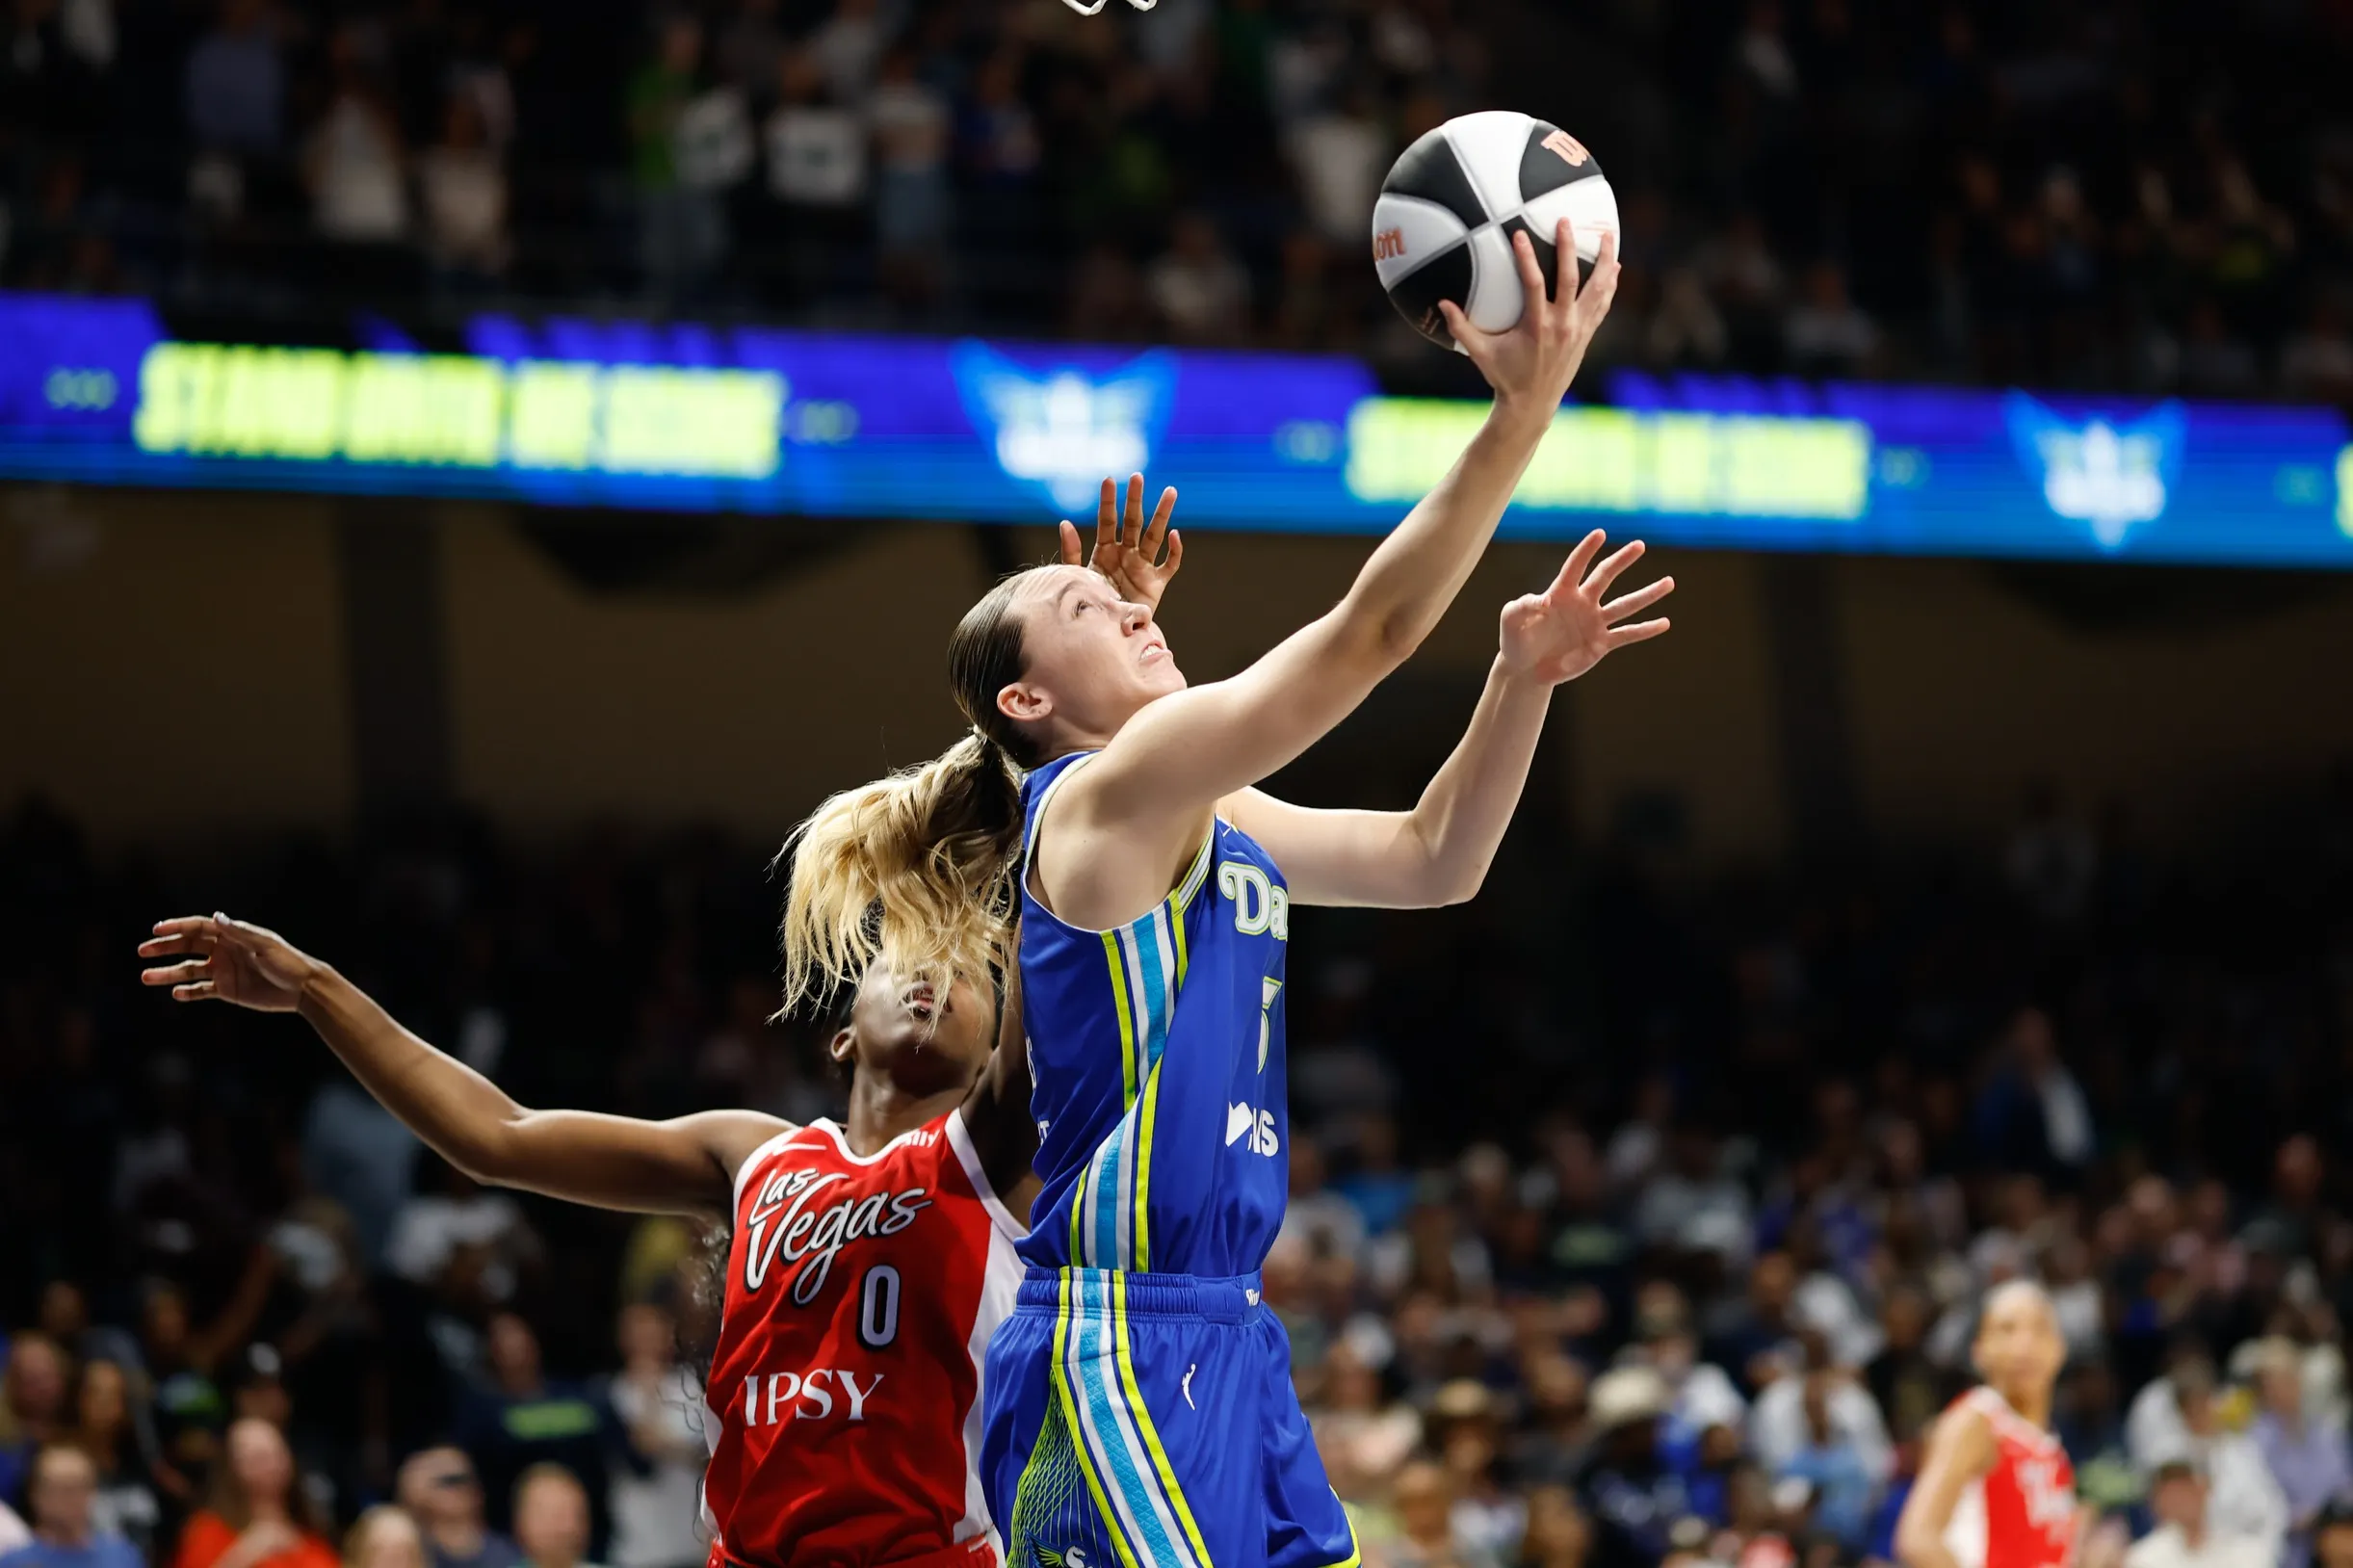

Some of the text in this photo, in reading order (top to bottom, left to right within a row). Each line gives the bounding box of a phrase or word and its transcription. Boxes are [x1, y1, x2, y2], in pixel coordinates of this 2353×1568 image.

[1217, 860, 1289, 941] Da
[747, 1167, 821, 1226] Las
[745, 1172, 933, 1306] Vegas
[857, 1264, 902, 1347] 0
[745, 1369, 885, 1427] IPSY
